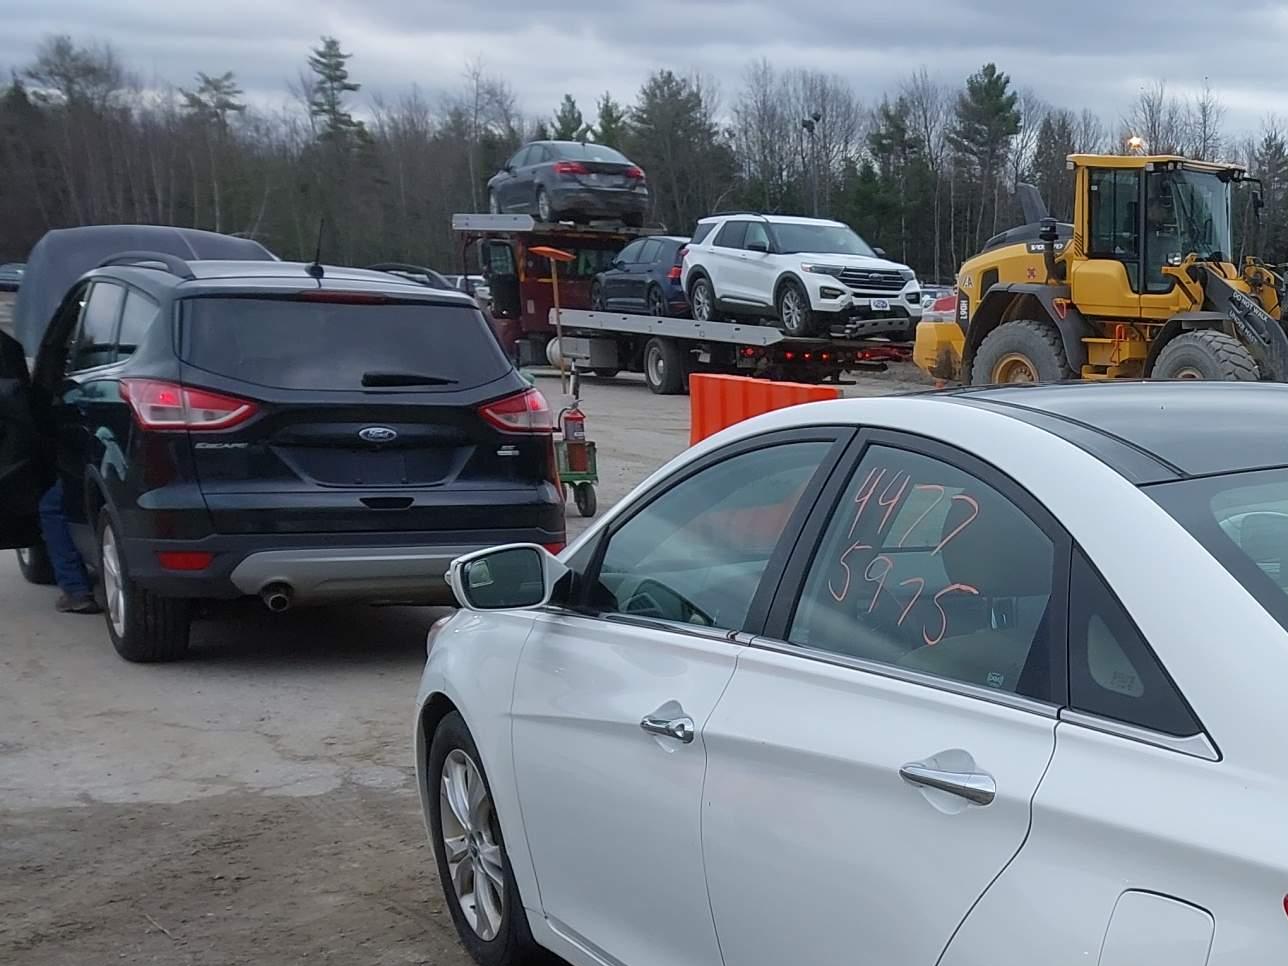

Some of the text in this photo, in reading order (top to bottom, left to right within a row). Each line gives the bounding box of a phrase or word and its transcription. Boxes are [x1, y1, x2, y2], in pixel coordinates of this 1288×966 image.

[1030, 243, 1064, 251] VOO
[364, 429, 393, 440] Ford
[848, 466, 979, 557] 4477
[828, 540, 979, 645] 5975
